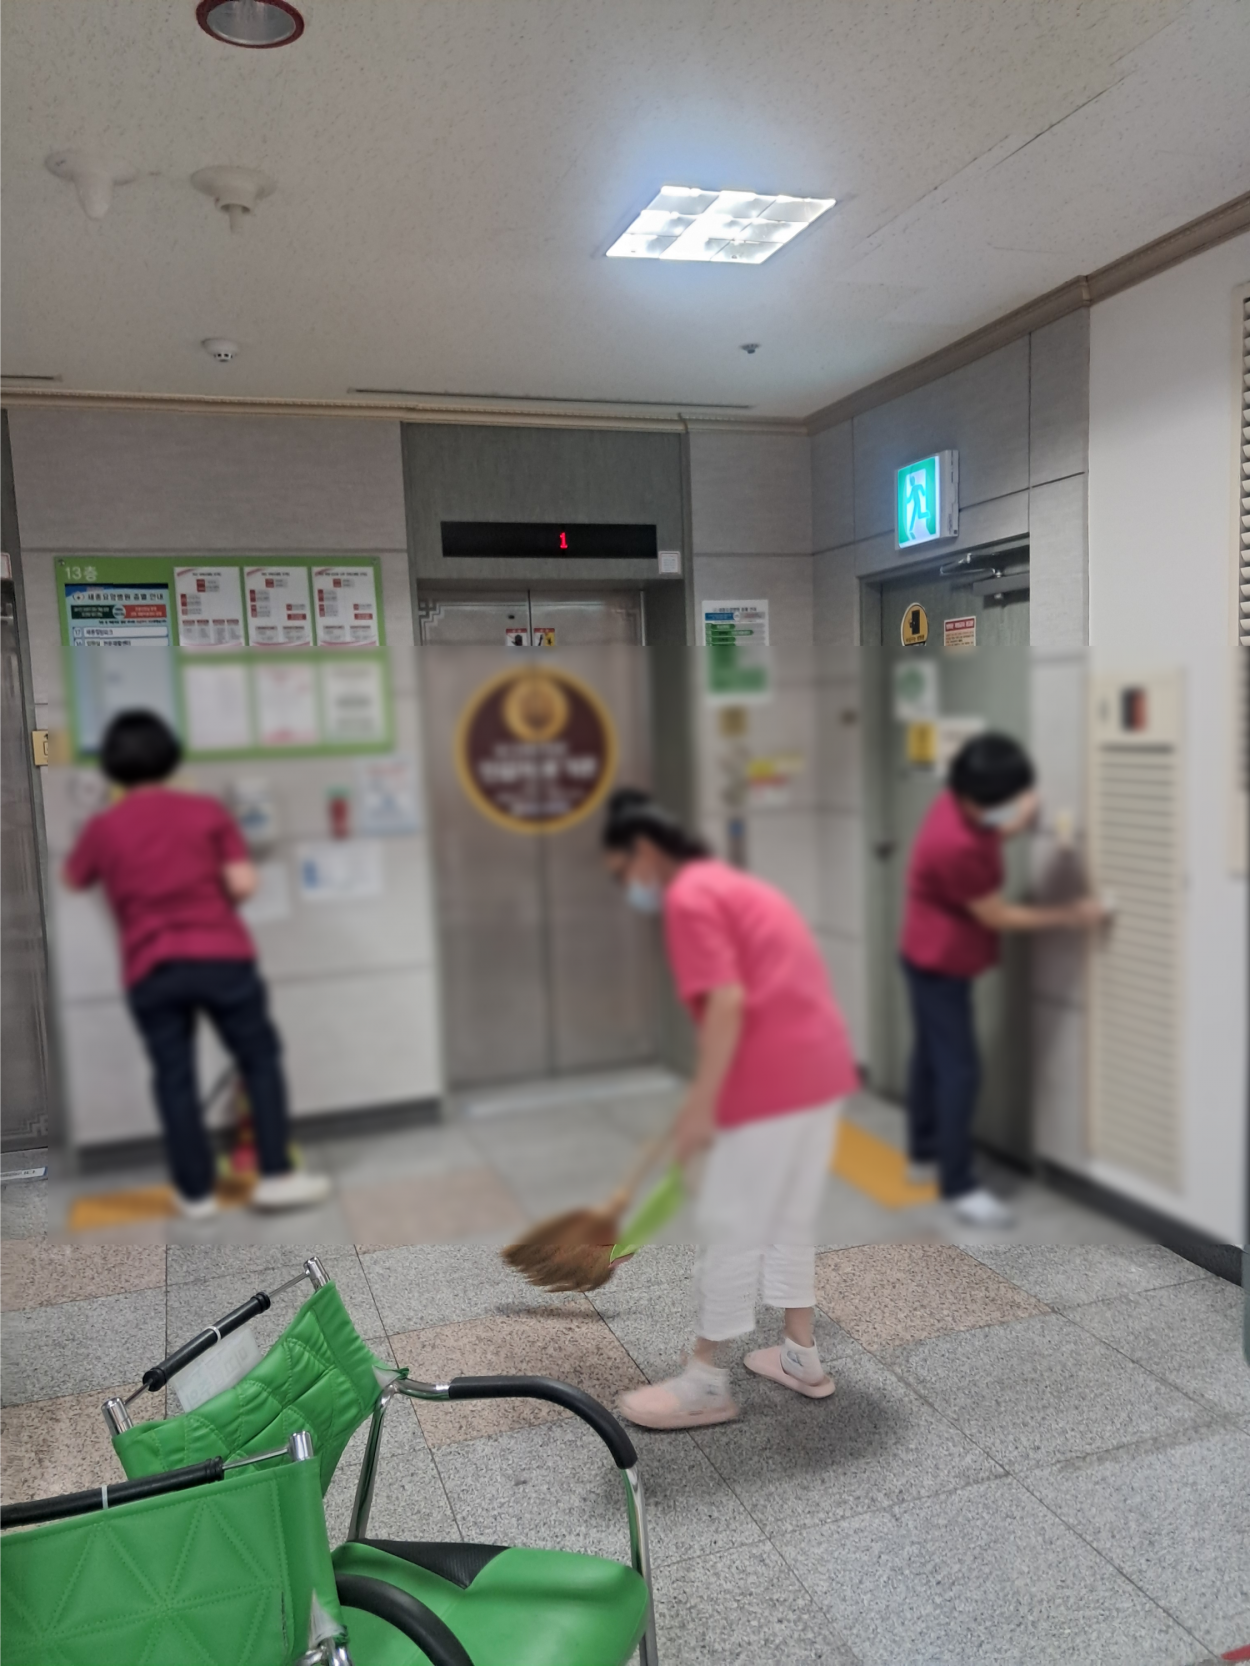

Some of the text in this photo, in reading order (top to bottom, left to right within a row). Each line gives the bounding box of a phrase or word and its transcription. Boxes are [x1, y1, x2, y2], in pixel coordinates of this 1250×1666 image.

[559, 531, 568, 549] 1
[64, 566, 98, 581] 13층
[149, 592, 164, 601] 안내
